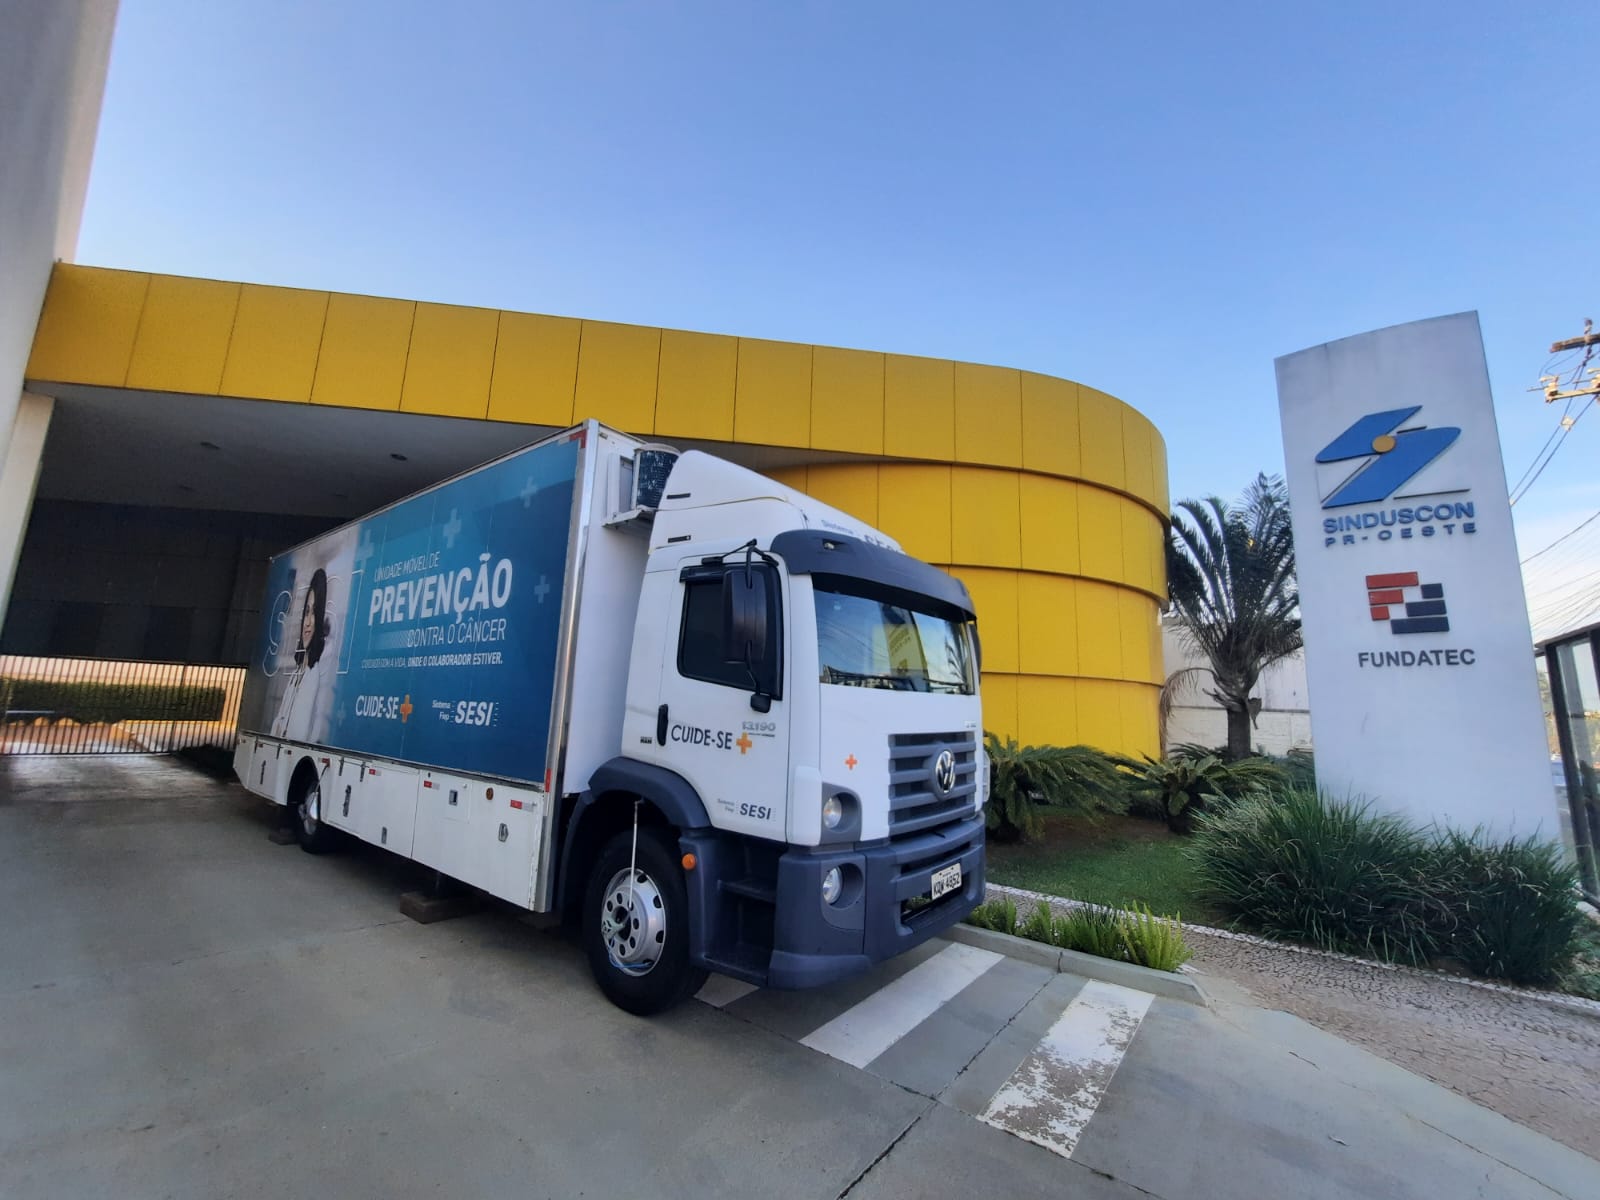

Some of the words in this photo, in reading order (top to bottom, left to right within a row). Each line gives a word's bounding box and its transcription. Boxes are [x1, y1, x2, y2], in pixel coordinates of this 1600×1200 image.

[1323, 501, 1475, 534] SINDUSCON
[428, 550, 440, 569] DE
[368, 552, 513, 627] PREVENÇÃO
[407, 625, 444, 648] CONTRA
[447, 624, 456, 644] O
[457, 616, 507, 643] CÂNCER
[407, 656, 423, 667] ONDE
[428, 653, 471, 666] COLABORADOR
[472, 651, 503, 665] ESTIVER.
[1357, 648, 1476, 668] FUNDATEC
[355, 694, 400, 720] CUIDE-SE
[454, 700, 494, 726] SESI
[671, 724, 733, 750] CUIDE-SE
[739, 802, 772, 820] SESI
